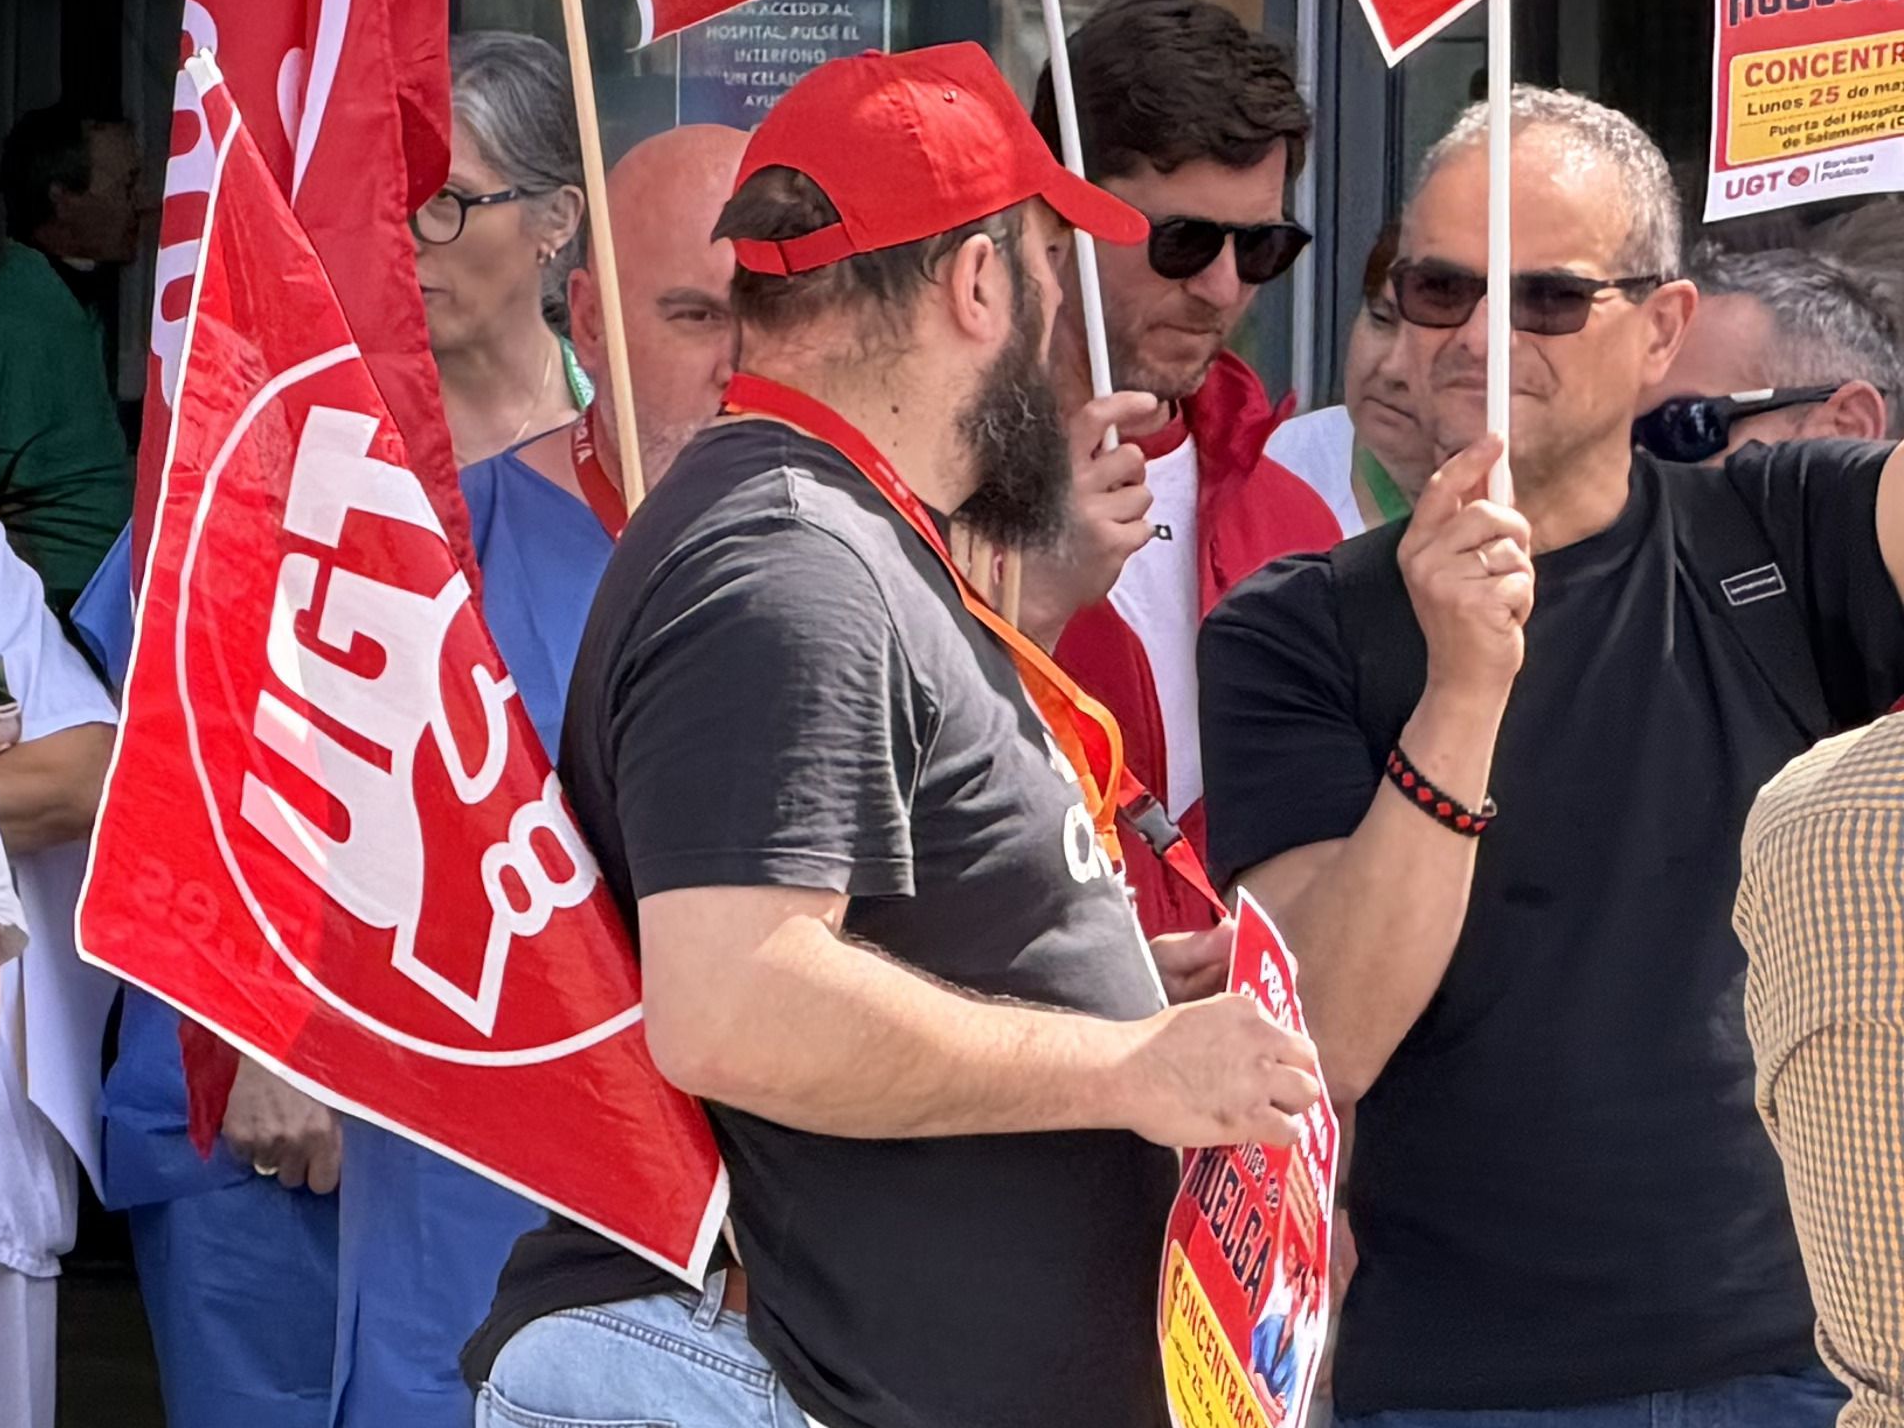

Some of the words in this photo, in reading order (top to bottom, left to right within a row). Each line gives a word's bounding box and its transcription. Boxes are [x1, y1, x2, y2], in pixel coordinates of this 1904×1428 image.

[1744, 41, 1904, 88] CONCENTR
[1747, 97, 1804, 116] Lunes
[1809, 85, 1840, 108] 25
[1847, 86, 1869, 100] de
[1850, 104, 1904, 121] Hospita
[1725, 170, 1784, 200] UGT
[240, 405, 447, 930] UGT
